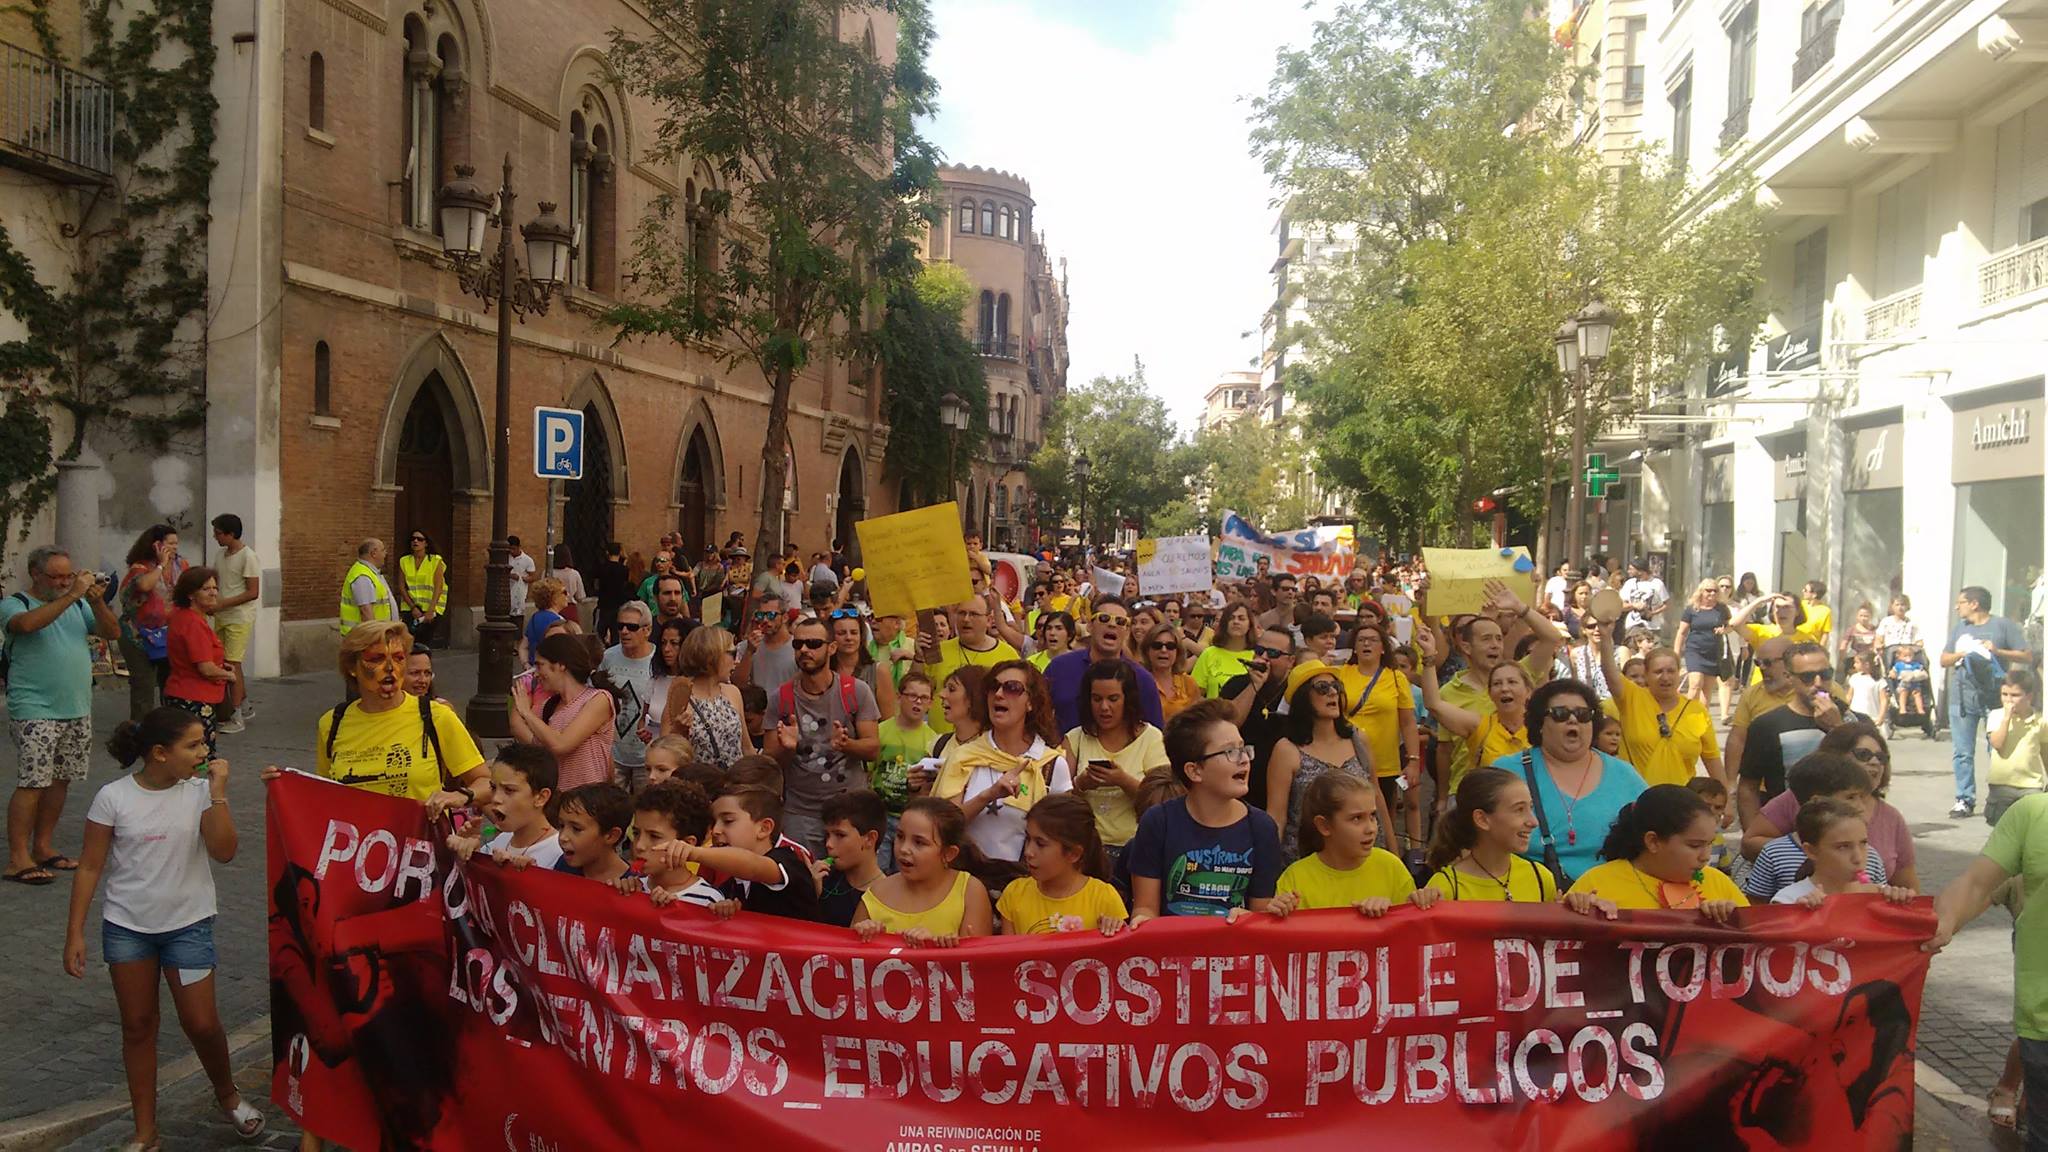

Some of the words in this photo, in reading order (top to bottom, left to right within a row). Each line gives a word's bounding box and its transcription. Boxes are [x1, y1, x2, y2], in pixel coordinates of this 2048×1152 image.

[546, 416, 574, 470] P
[1971, 408, 2027, 445] Amichi
[1180, 883, 1191, 893] 63
[1198, 883, 1231, 896] BEACH
[315, 819, 436, 903] POR
[508, 900, 976, 1024] CLIMATIZACIÓN
[1014, 942, 1460, 1026] SOSTENIBLE
[1493, 939, 1587, 1011] DE
[1618, 937, 1857, 1004] TODOS
[448, 935, 520, 1026] LOS
[822, 1035, 1269, 1112] EDUCATIVOS
[900, 1125, 924, 1138] UNA
[927, 1126, 1022, 1141] REIVINDICACIÓN
[1025, 1130, 1041, 1142] DE
